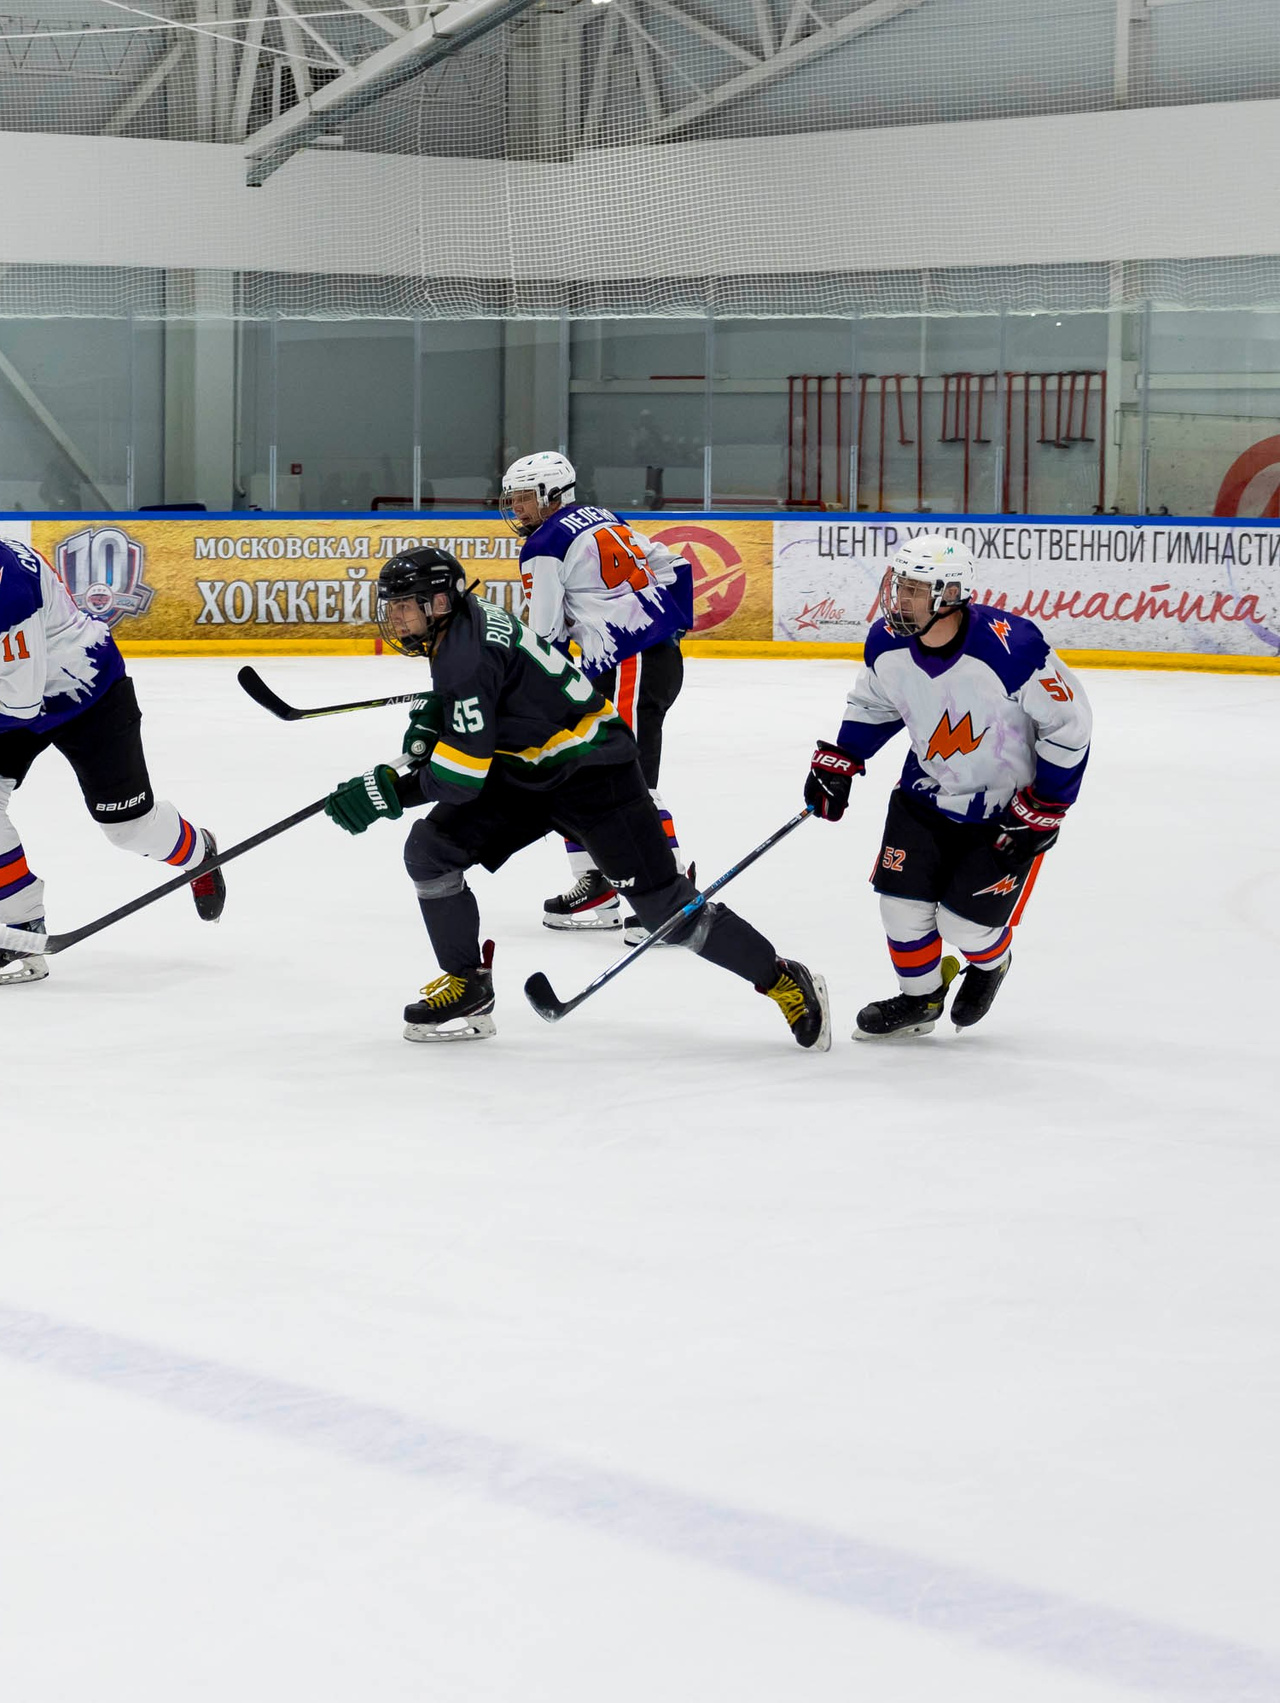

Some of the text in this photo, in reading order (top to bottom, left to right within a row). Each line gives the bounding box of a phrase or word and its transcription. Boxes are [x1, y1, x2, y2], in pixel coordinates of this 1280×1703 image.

[194, 536, 371, 560] МОСКОВСКАЯ
[818, 525, 898, 560] ЦЕНТР
[906, 524, 1145, 563] ОЖЕСТВЕННОЙ
[66, 528, 129, 597] 10
[970, 583, 1267, 623] имнастика
[2, 630, 30, 663] 11
[451, 695, 486, 735] 55
[811, 752, 852, 772] UER
[95, 791, 147, 812] BAUER
[881, 846, 907, 872] 52
[609, 876, 636, 889] CM
[569, 895, 588, 908] CCM
